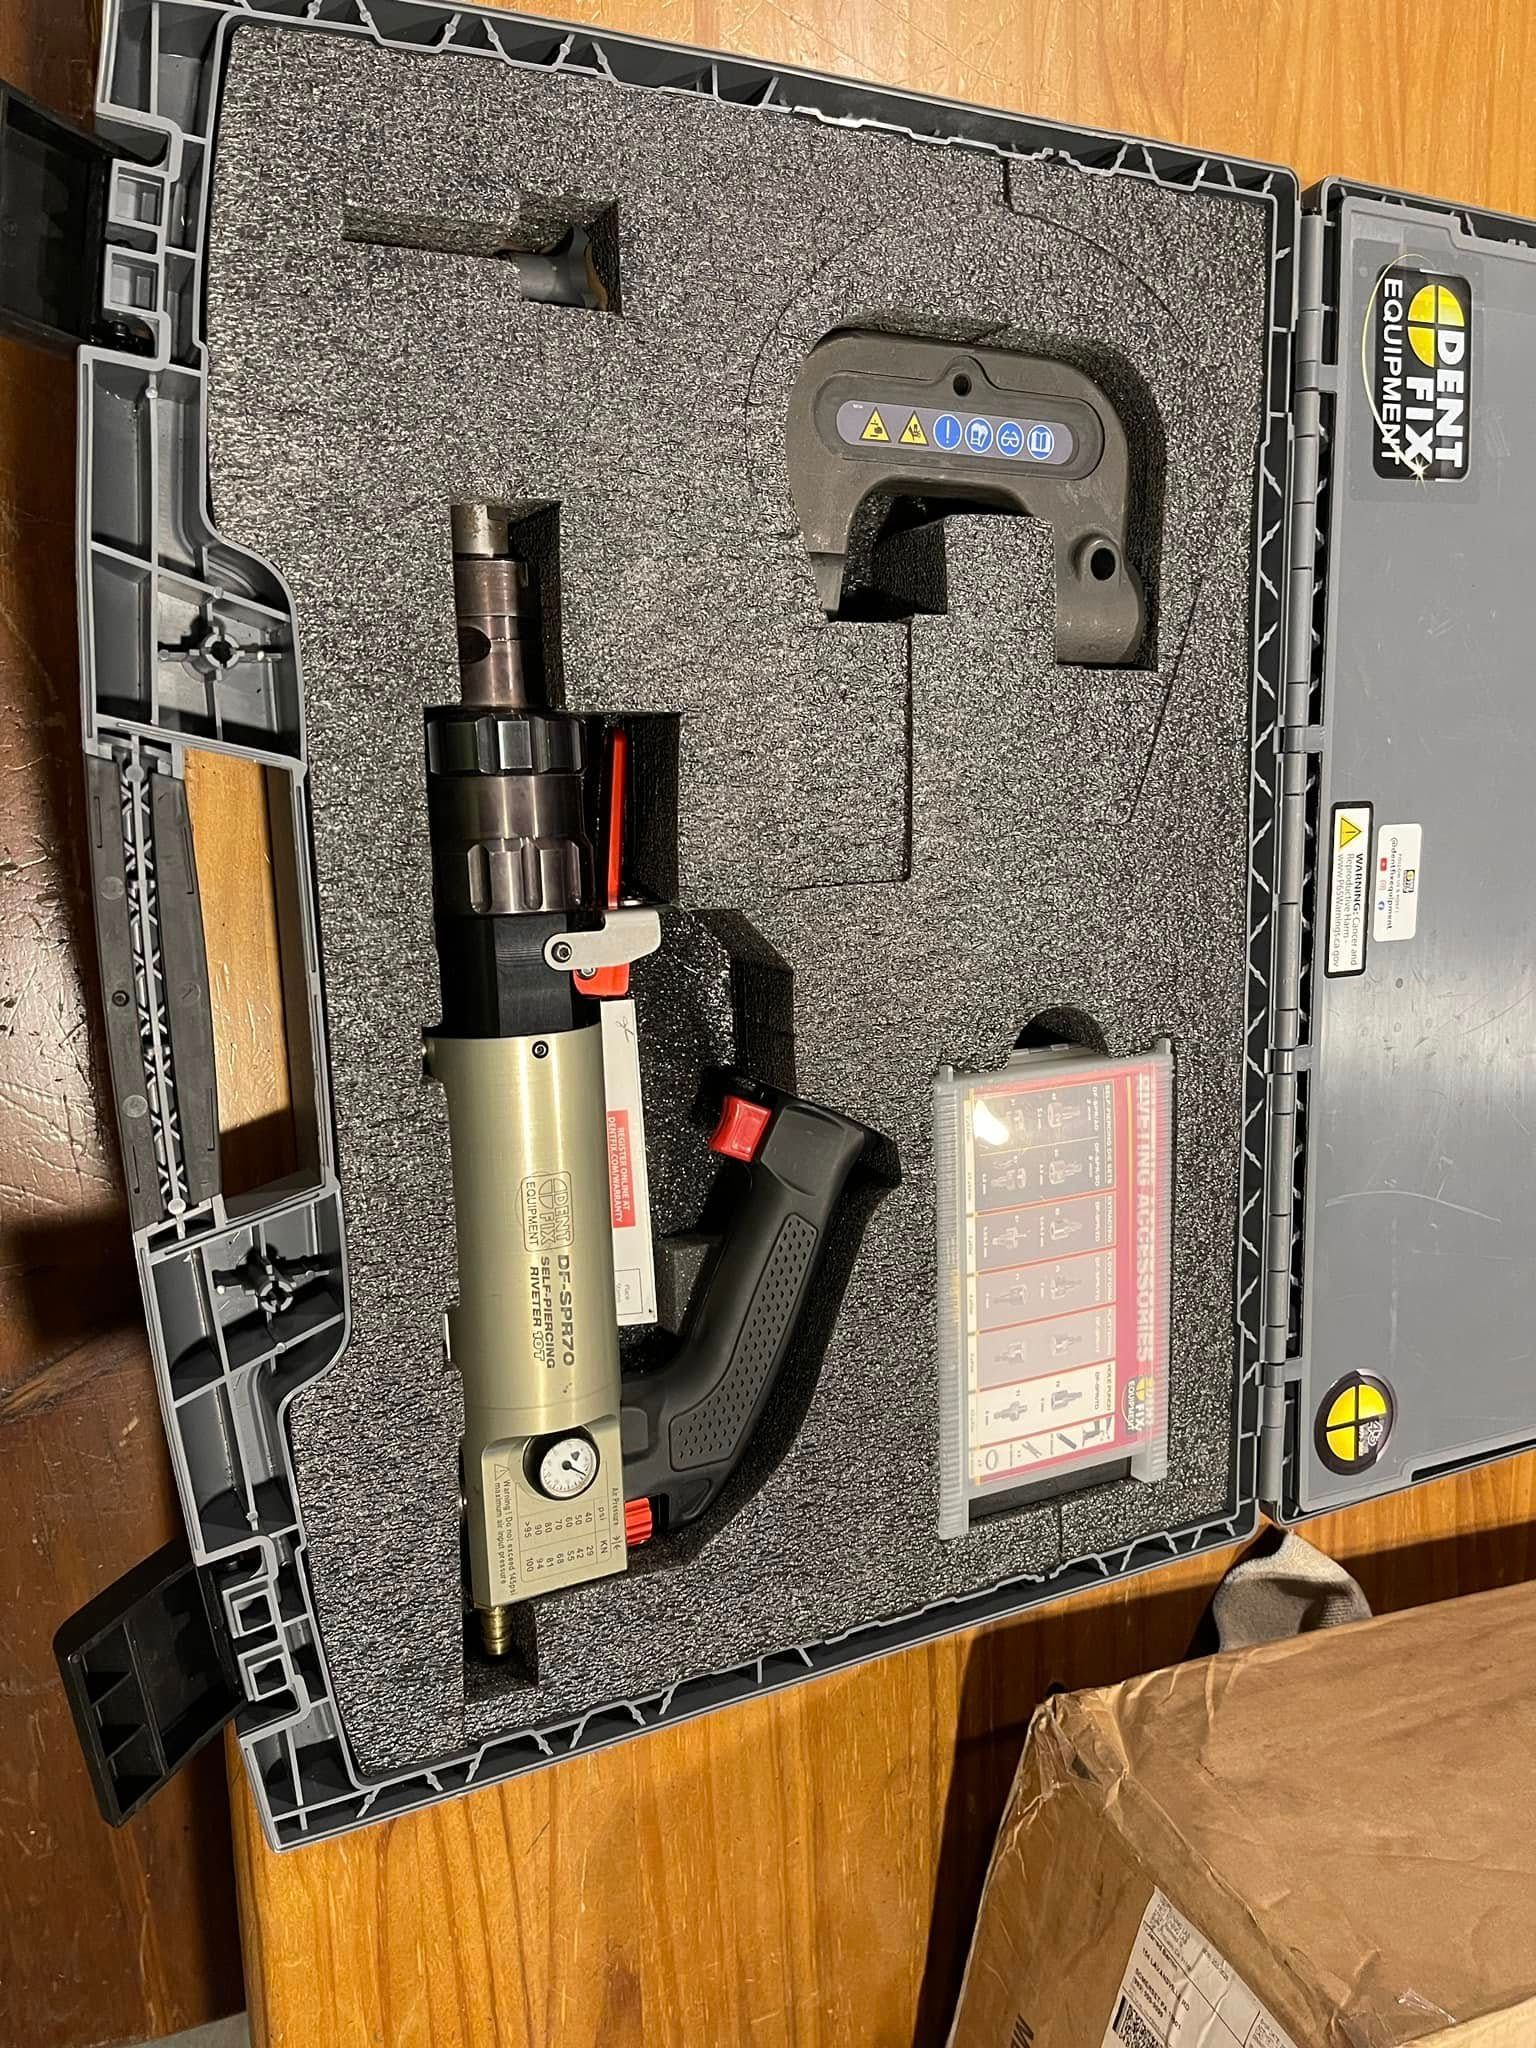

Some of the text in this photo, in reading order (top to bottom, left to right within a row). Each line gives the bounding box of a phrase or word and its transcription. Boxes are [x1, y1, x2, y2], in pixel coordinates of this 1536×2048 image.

[1381, 278, 1403, 465] EQUIPMENT
[1404, 377, 1433, 464] FIX
[1435, 330, 1465, 467] DENT
[1344, 854, 1354, 912] Reproductive
[1386, 837, 1398, 930] @dentfixequipment
[1333, 854, 1344, 967] www.P65Warnings.ca.gov
[1343, 914, 1352, 938] Harm
[1350, 854, 1363, 965] WARNING: Cancer and
[608, 1117, 622, 1223] DENTFIX.COM/WARRANTY
[618, 1128, 627, 1166] REGISTER
[526, 1182, 538, 1246] EQUIPMENT
[555, 1195, 570, 1242] DENT
[622, 1201, 630, 1210] AT
[1136, 1073, 1156, 1363] RIVETING ACCESSORIES
[539, 1213, 554, 1245] FIX
[530, 1267, 545, 1361] RIVETER 10T
[541, 1256, 555, 1368] SELF-PIERCING
[558, 1255, 575, 1366] DF-SPR70
[1127, 1380, 1135, 1431] EQUIPMENT
[1135, 1404, 1145, 1431] FIX
[495, 1483, 503, 1517] maximum
[503, 1480, 511, 1510] Warning
[497, 1530, 505, 1549] input
[505, 1517, 512, 1527] Do
[545, 1522, 553, 1567] 80 81
[555, 1520, 564, 1564] 70 68
[566, 1517, 574, 1561] 60 55
[575, 1515, 583, 1559] 50 42
[585, 1512, 594, 1556] 40 29
[597, 1507, 607, 1554] psi KN
[498, 1552, 507, 1584] pressure
[524, 1522, 534, 1572] >95 100
[535, 1525, 543, 1569] 90 94
[508, 1572, 517, 1596] 145psi
